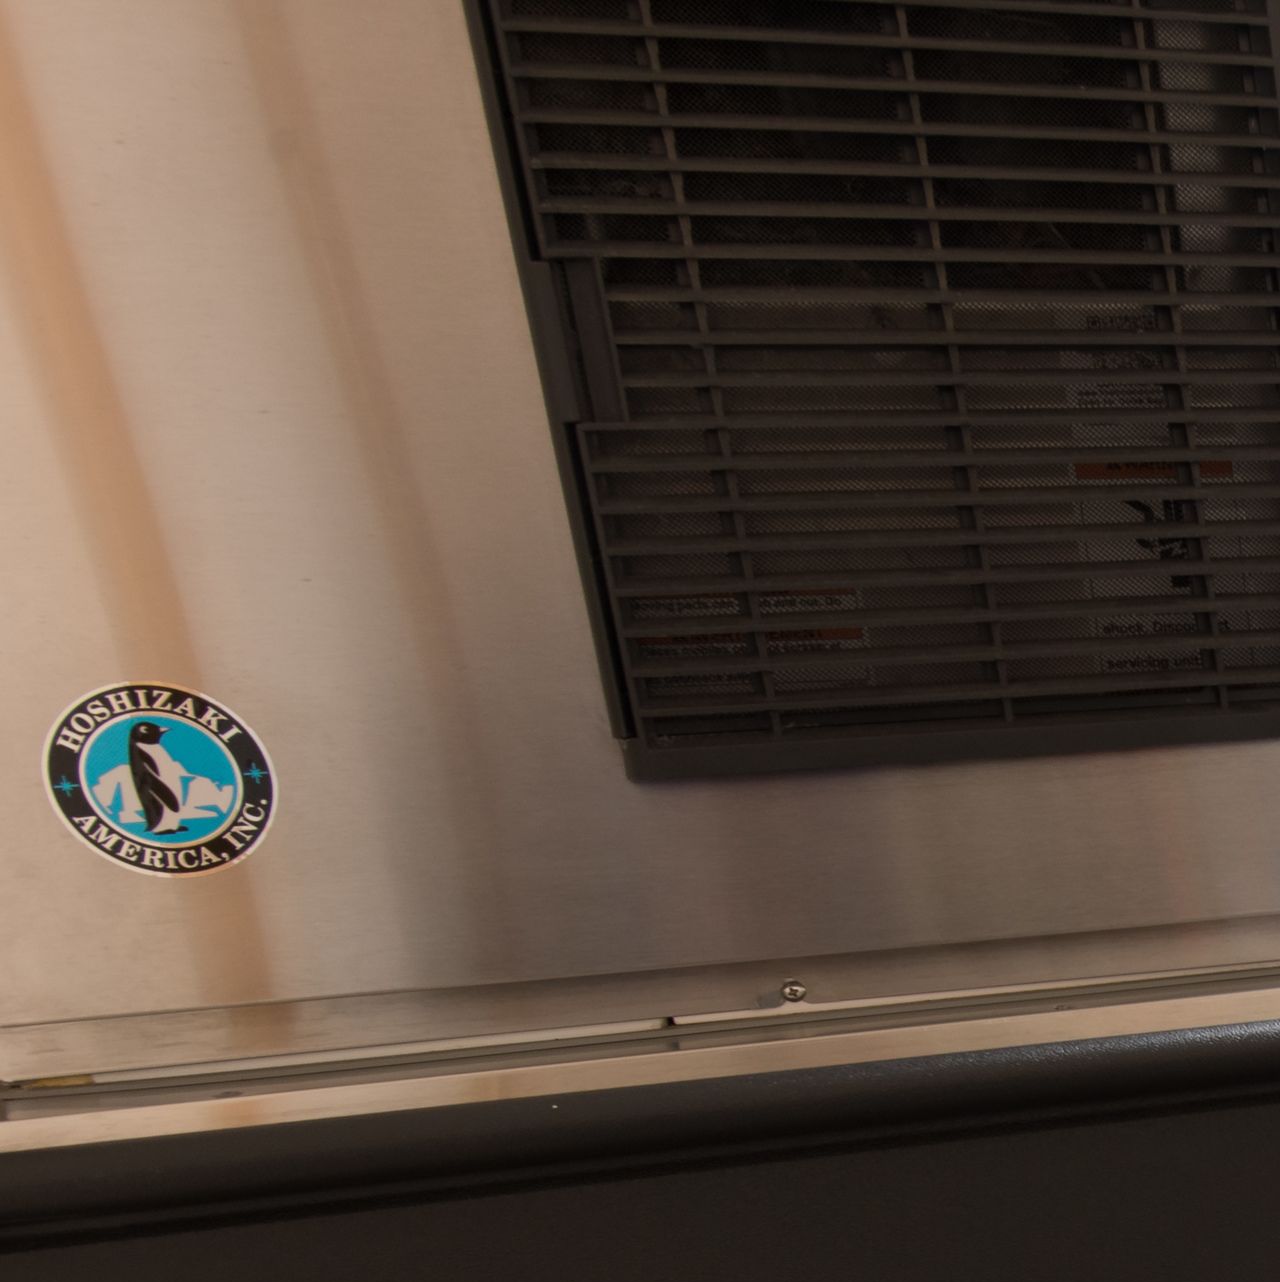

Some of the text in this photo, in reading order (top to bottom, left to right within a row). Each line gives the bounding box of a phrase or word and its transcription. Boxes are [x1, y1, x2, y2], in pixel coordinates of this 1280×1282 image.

[56, 688, 243, 754] HOSHIZAKI
[72, 798, 268, 870] AMERICA, INC.
